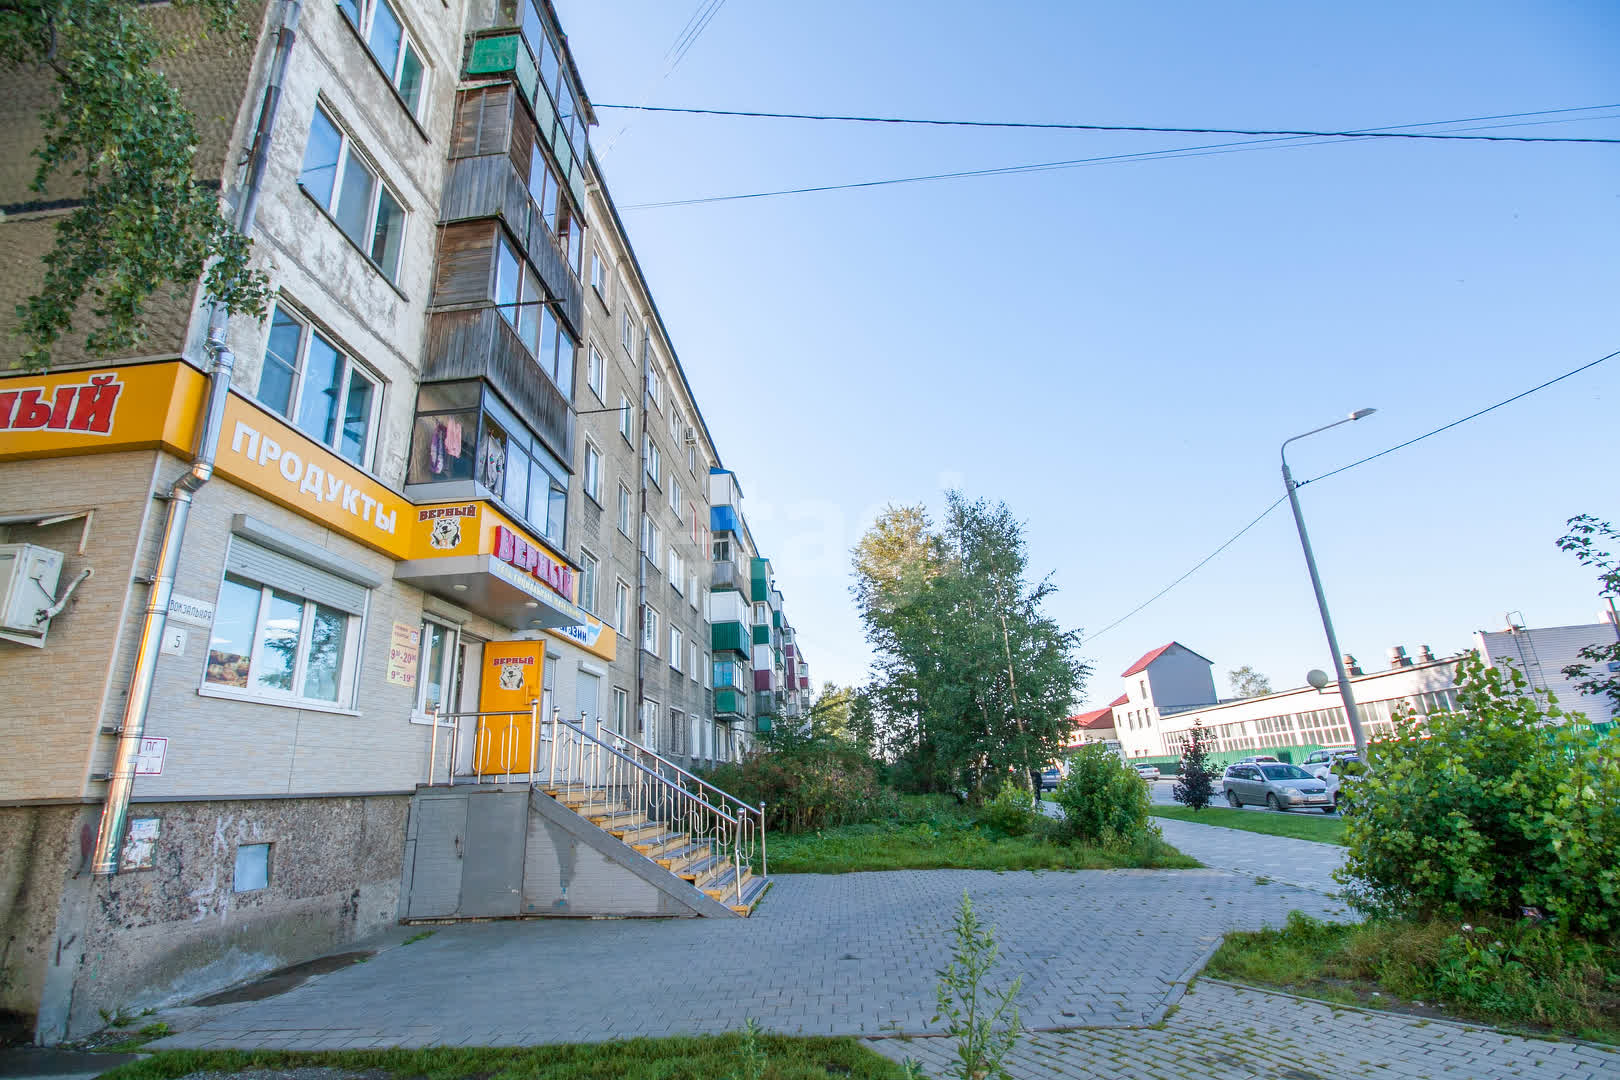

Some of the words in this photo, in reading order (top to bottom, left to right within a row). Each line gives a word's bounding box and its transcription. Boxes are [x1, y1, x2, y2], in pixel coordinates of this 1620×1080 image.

[232, 420, 397, 534] ПРОДУКТЫ
[418, 504, 477, 521] ВЕРНЫЙ
[494, 525, 574, 604] ВЕРНЫЙ
[174, 635, 181, 648] 5
[493, 656, 534, 666] ВЕРНЫЙ
